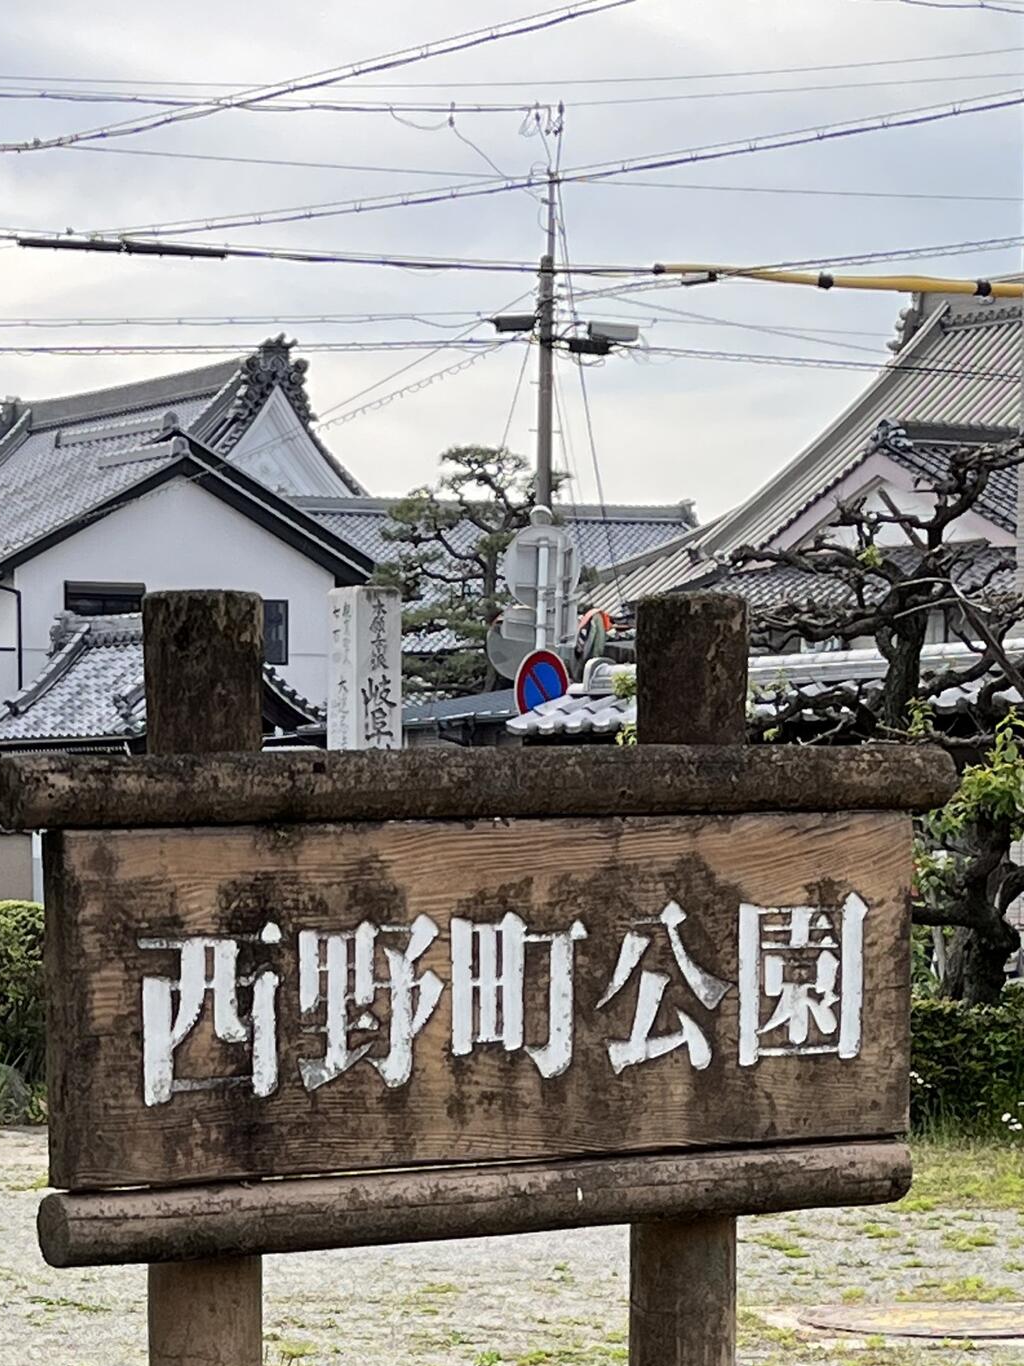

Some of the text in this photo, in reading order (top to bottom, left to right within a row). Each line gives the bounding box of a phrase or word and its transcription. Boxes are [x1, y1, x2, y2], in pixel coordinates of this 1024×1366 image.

[361, 600, 397, 750] 本願寺派岐阜
[136, 890, 869, 1107] 西野町公園
